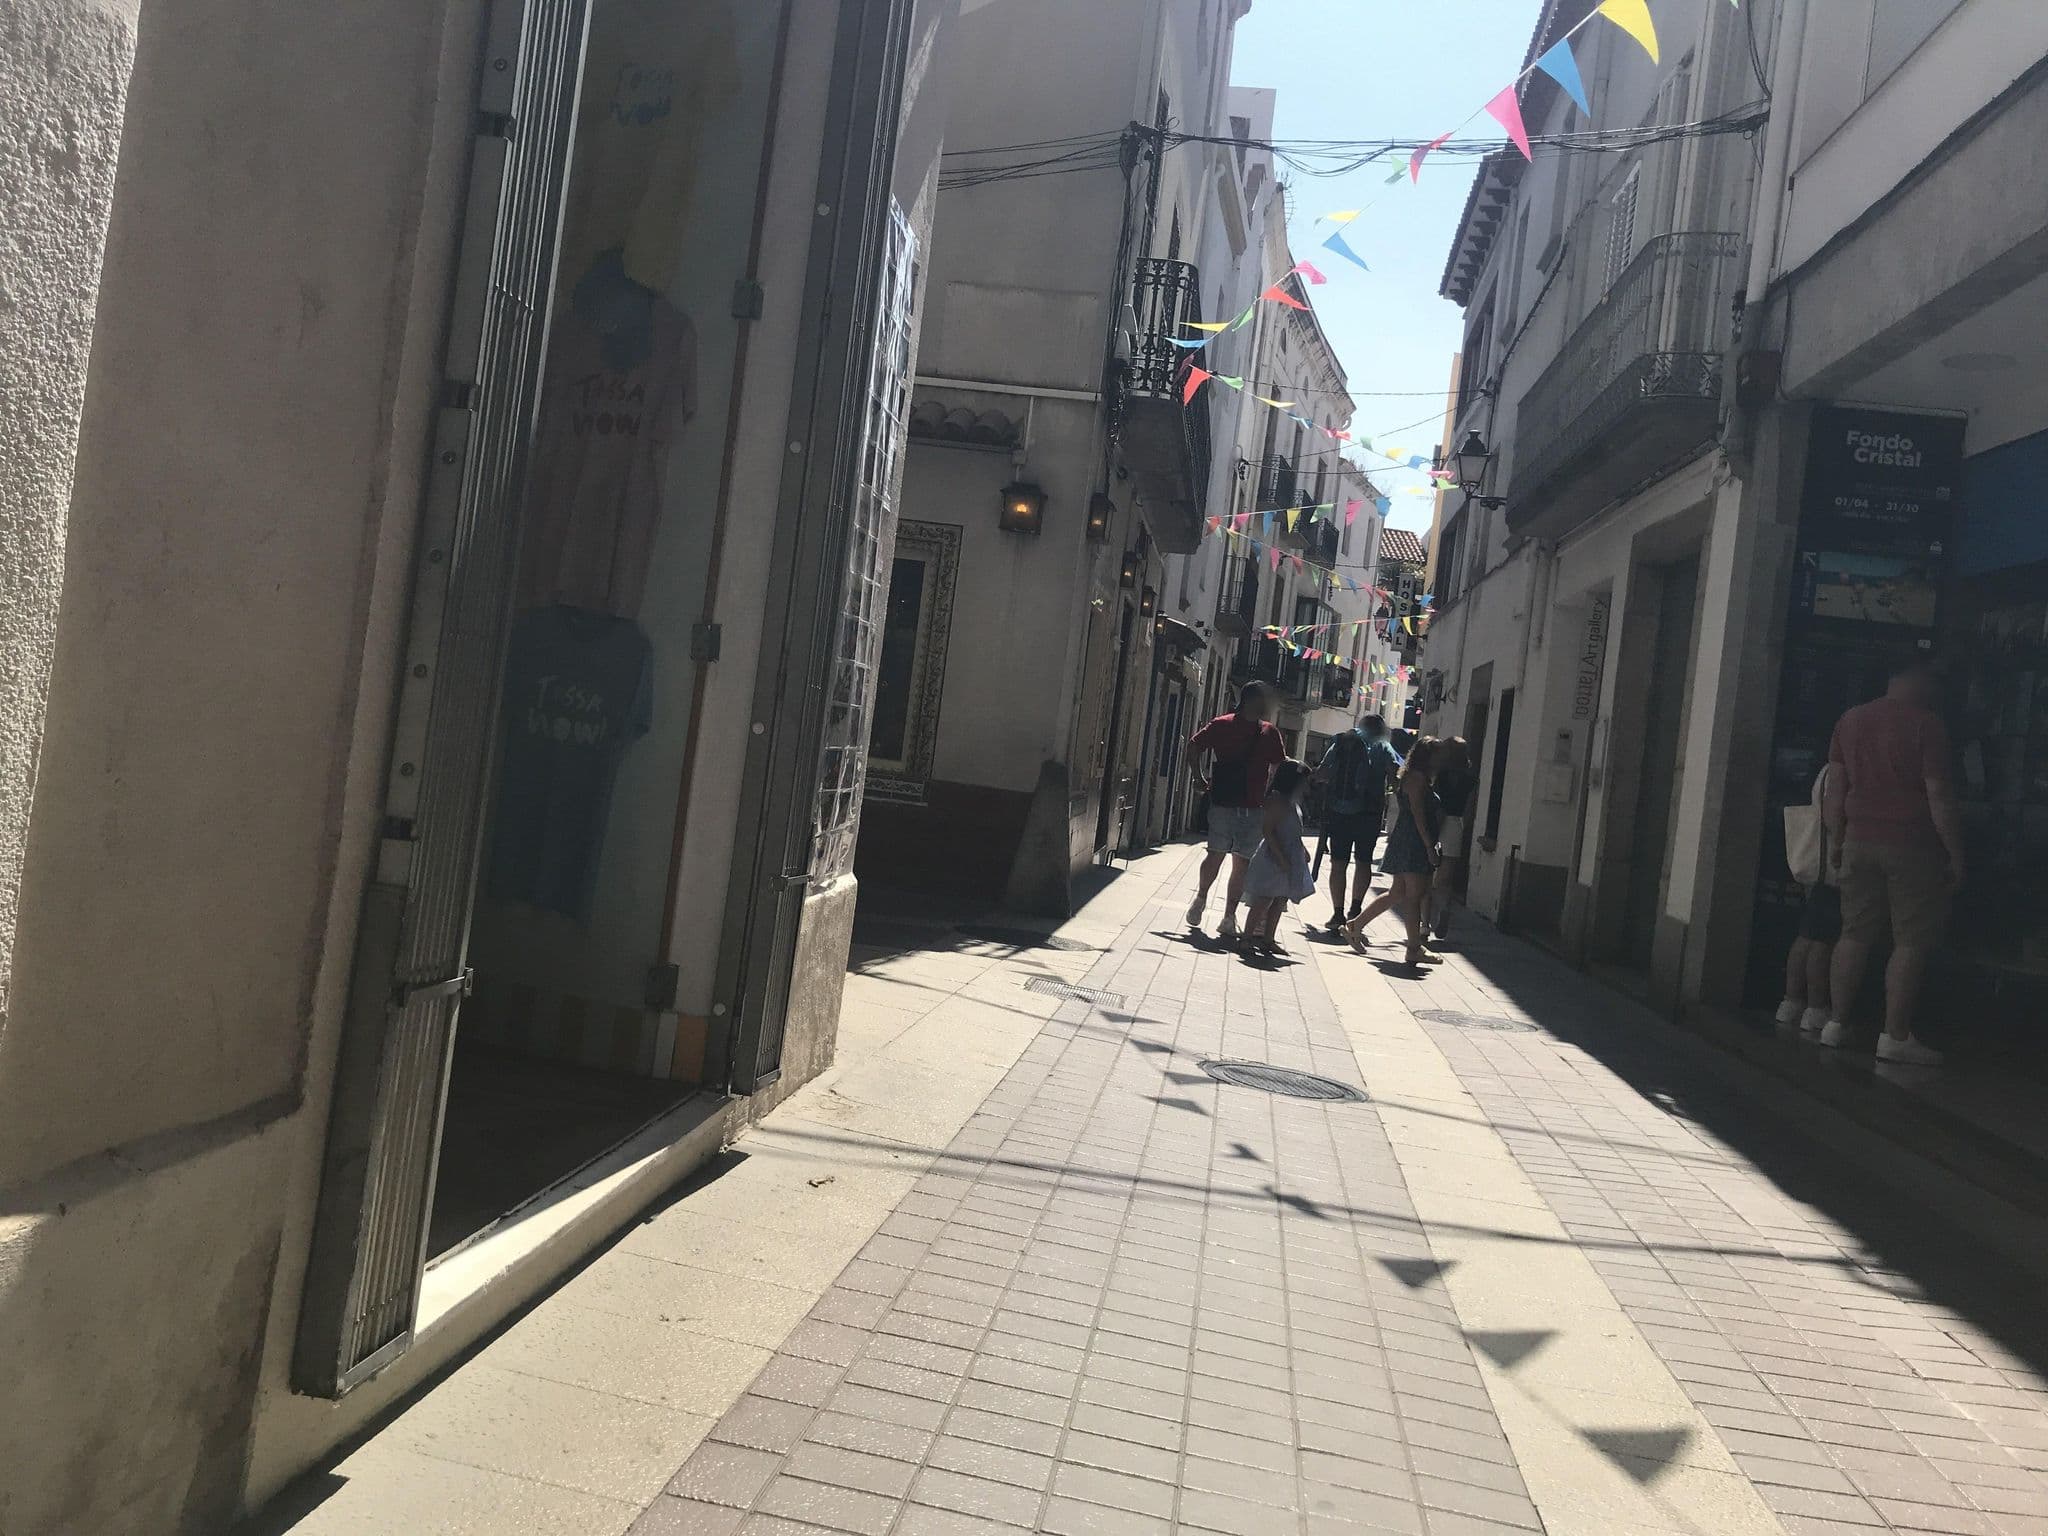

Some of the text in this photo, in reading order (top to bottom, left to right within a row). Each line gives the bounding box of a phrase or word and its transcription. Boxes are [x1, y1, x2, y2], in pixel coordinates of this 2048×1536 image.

[1846, 430, 1913, 451] Fondo
[1854, 447, 1921, 467] Cristal
[1395, 580, 1411, 645] HOSAL
